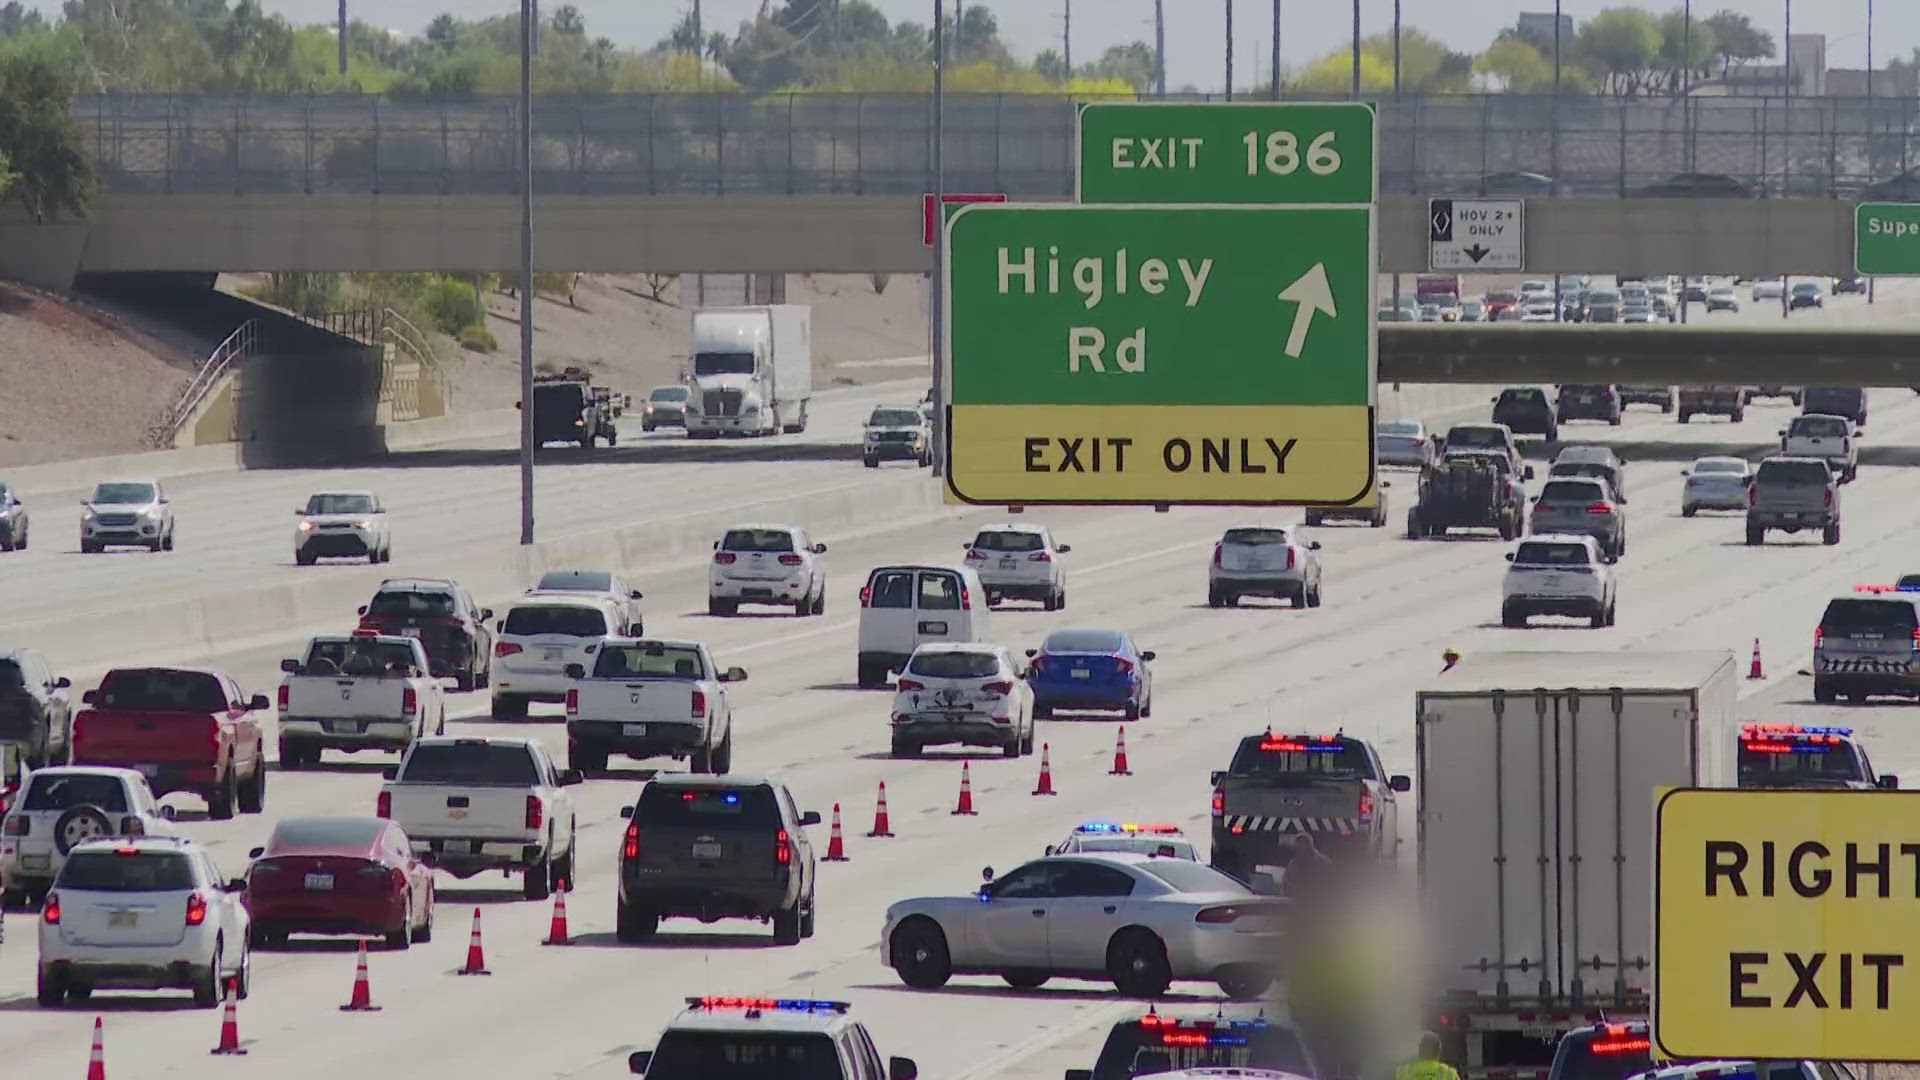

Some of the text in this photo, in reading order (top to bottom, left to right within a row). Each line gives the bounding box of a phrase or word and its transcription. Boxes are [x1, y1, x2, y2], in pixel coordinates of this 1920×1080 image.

[1112, 131, 1341, 176] EXIT 186
[1460, 210, 1487, 221] HOV
[1469, 225, 1504, 236] ONLY
[1869, 217, 1919, 238] Supe
[997, 246, 1214, 310] Higley
[1068, 326, 1146, 373] Rd
[1024, 437, 1298, 474] EXIT ONLY
[1730, 952, 1904, 1009] EXIT
